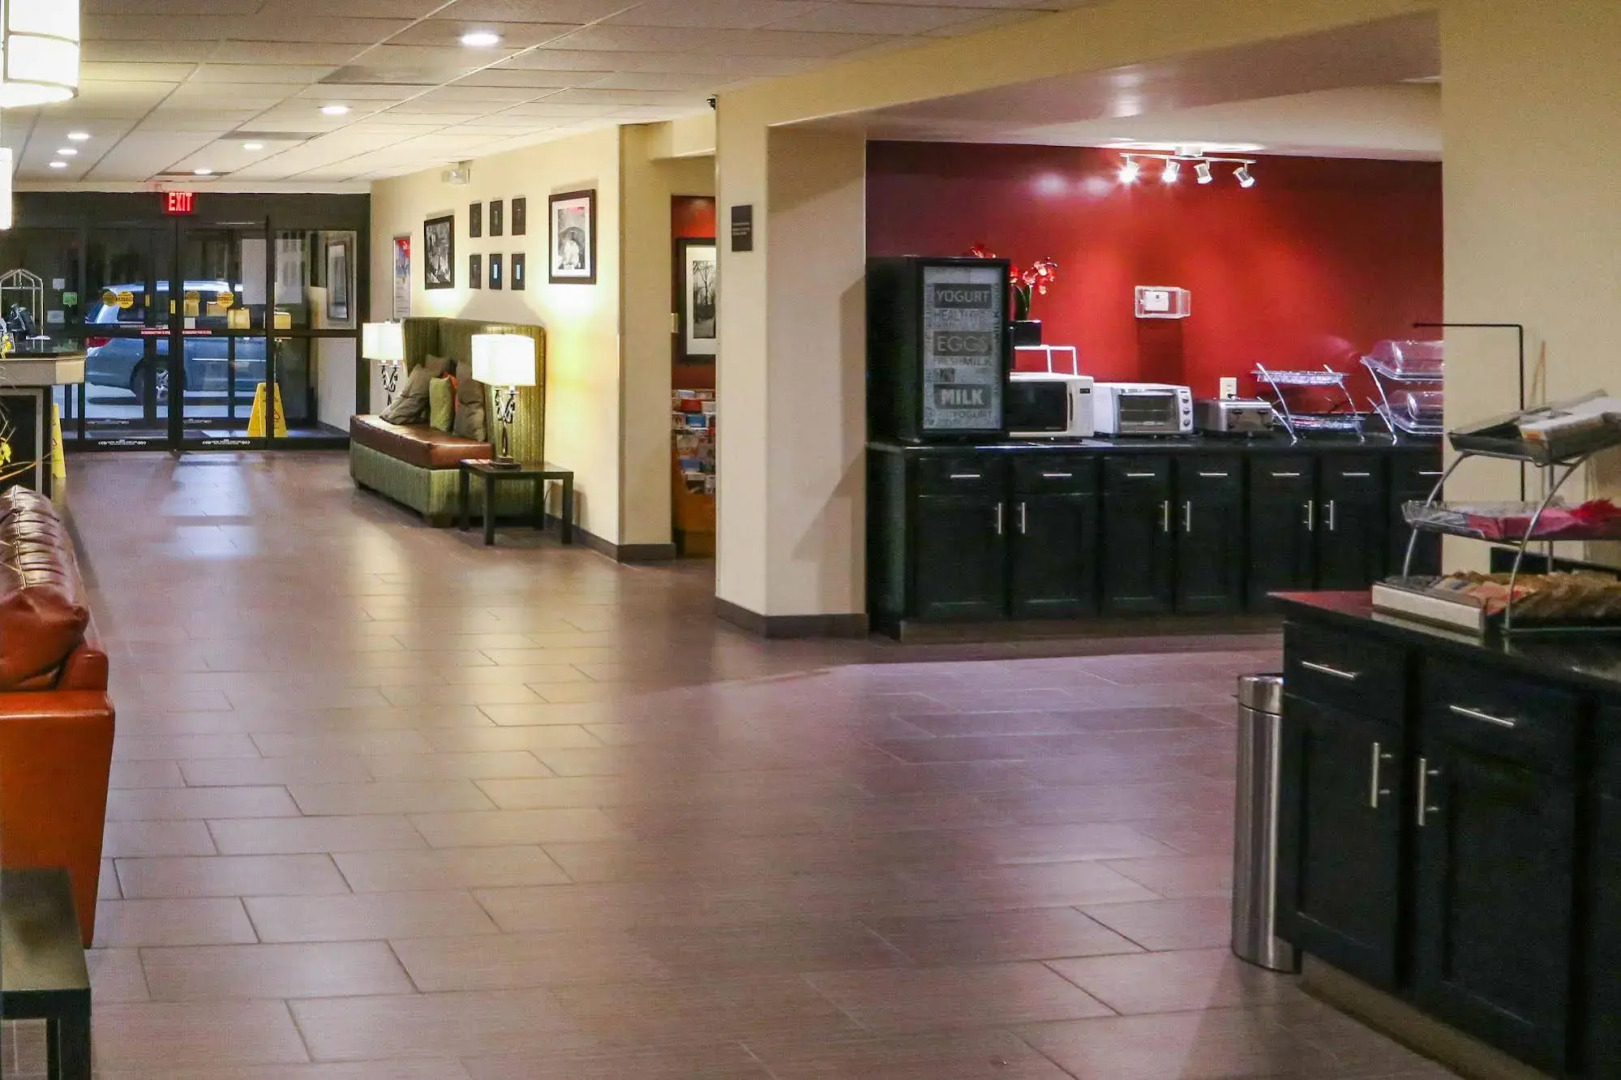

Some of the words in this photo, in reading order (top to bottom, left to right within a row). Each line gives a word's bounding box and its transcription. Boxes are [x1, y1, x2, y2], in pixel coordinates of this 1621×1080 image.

[168, 192, 192, 212] EXIT
[936, 290, 990, 303] YOGURT
[937, 335, 989, 353] EGGS
[940, 388, 985, 406] MILK
